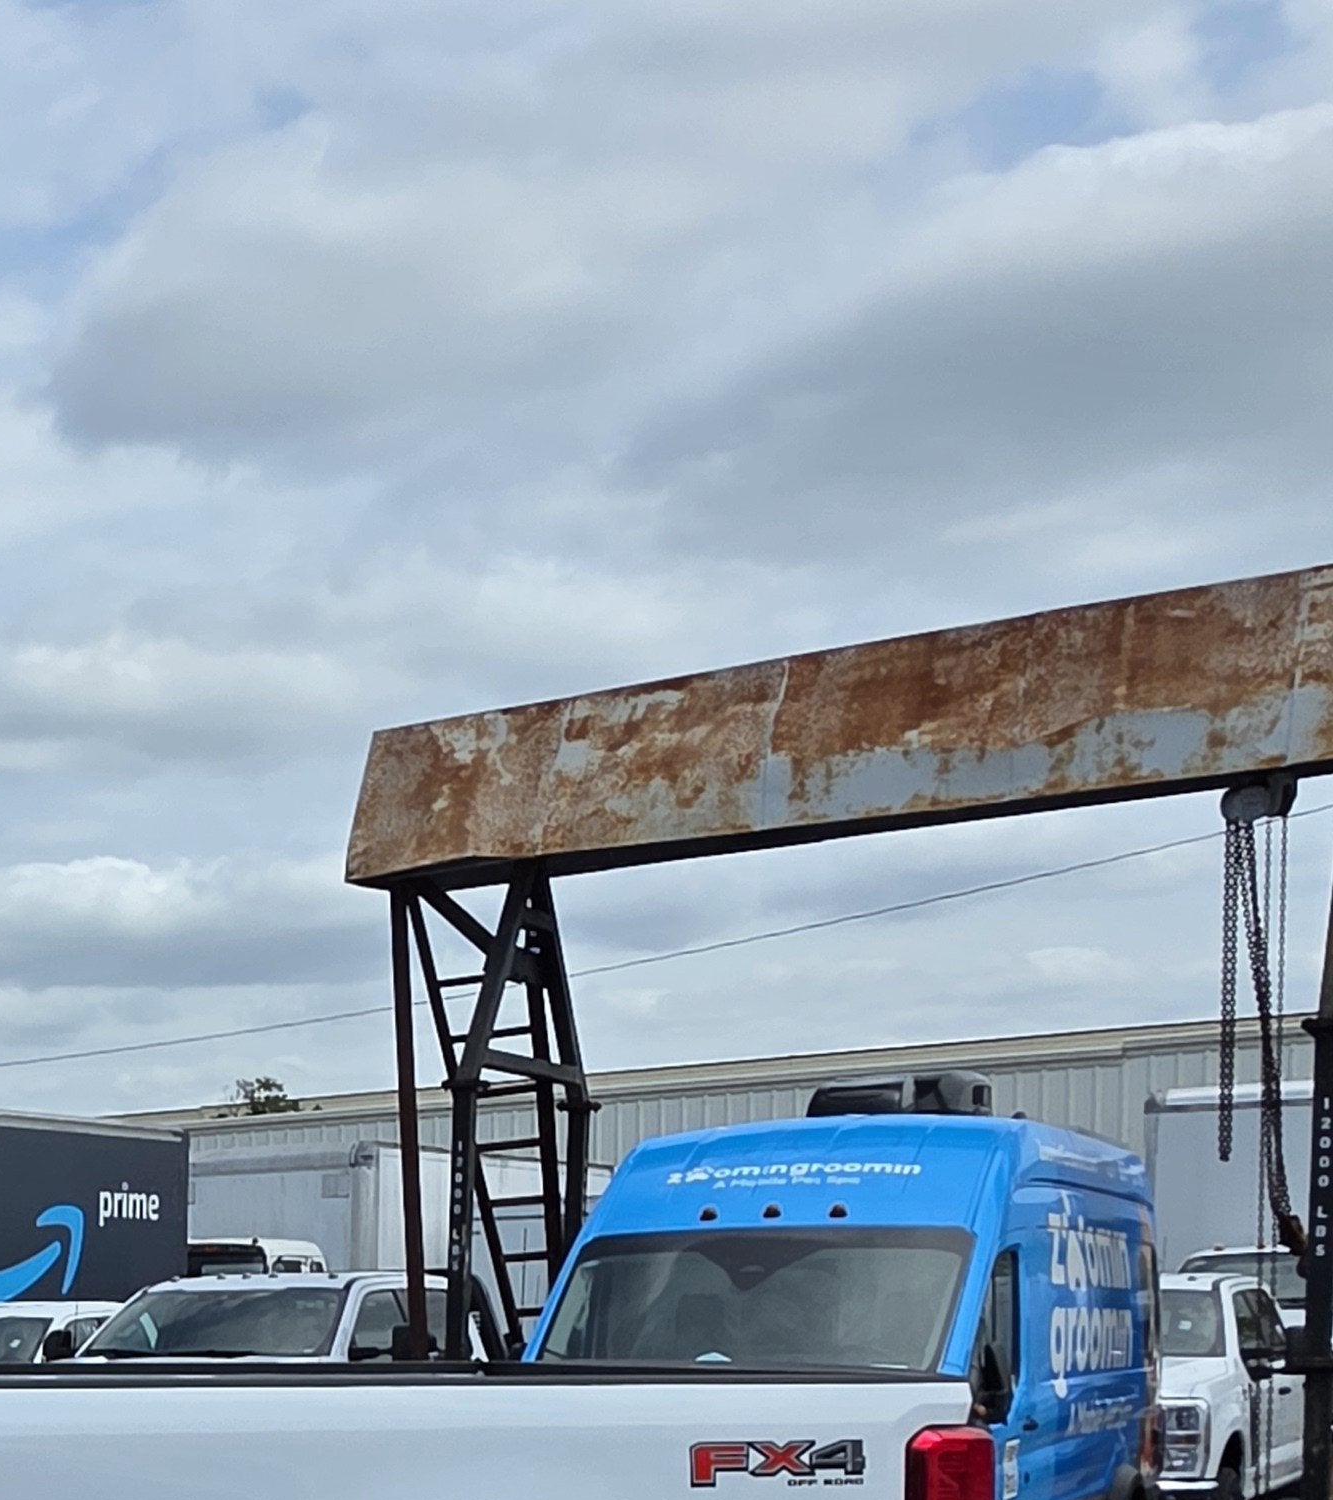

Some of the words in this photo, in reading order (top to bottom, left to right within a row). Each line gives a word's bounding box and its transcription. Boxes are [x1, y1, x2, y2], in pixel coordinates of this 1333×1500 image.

[98, 1181, 159, 1228] prime
[1049, 1306, 1133, 1398] groomin
[689, 1439, 866, 1488] FX4
[823, 1477, 864, 1486] ROAD
